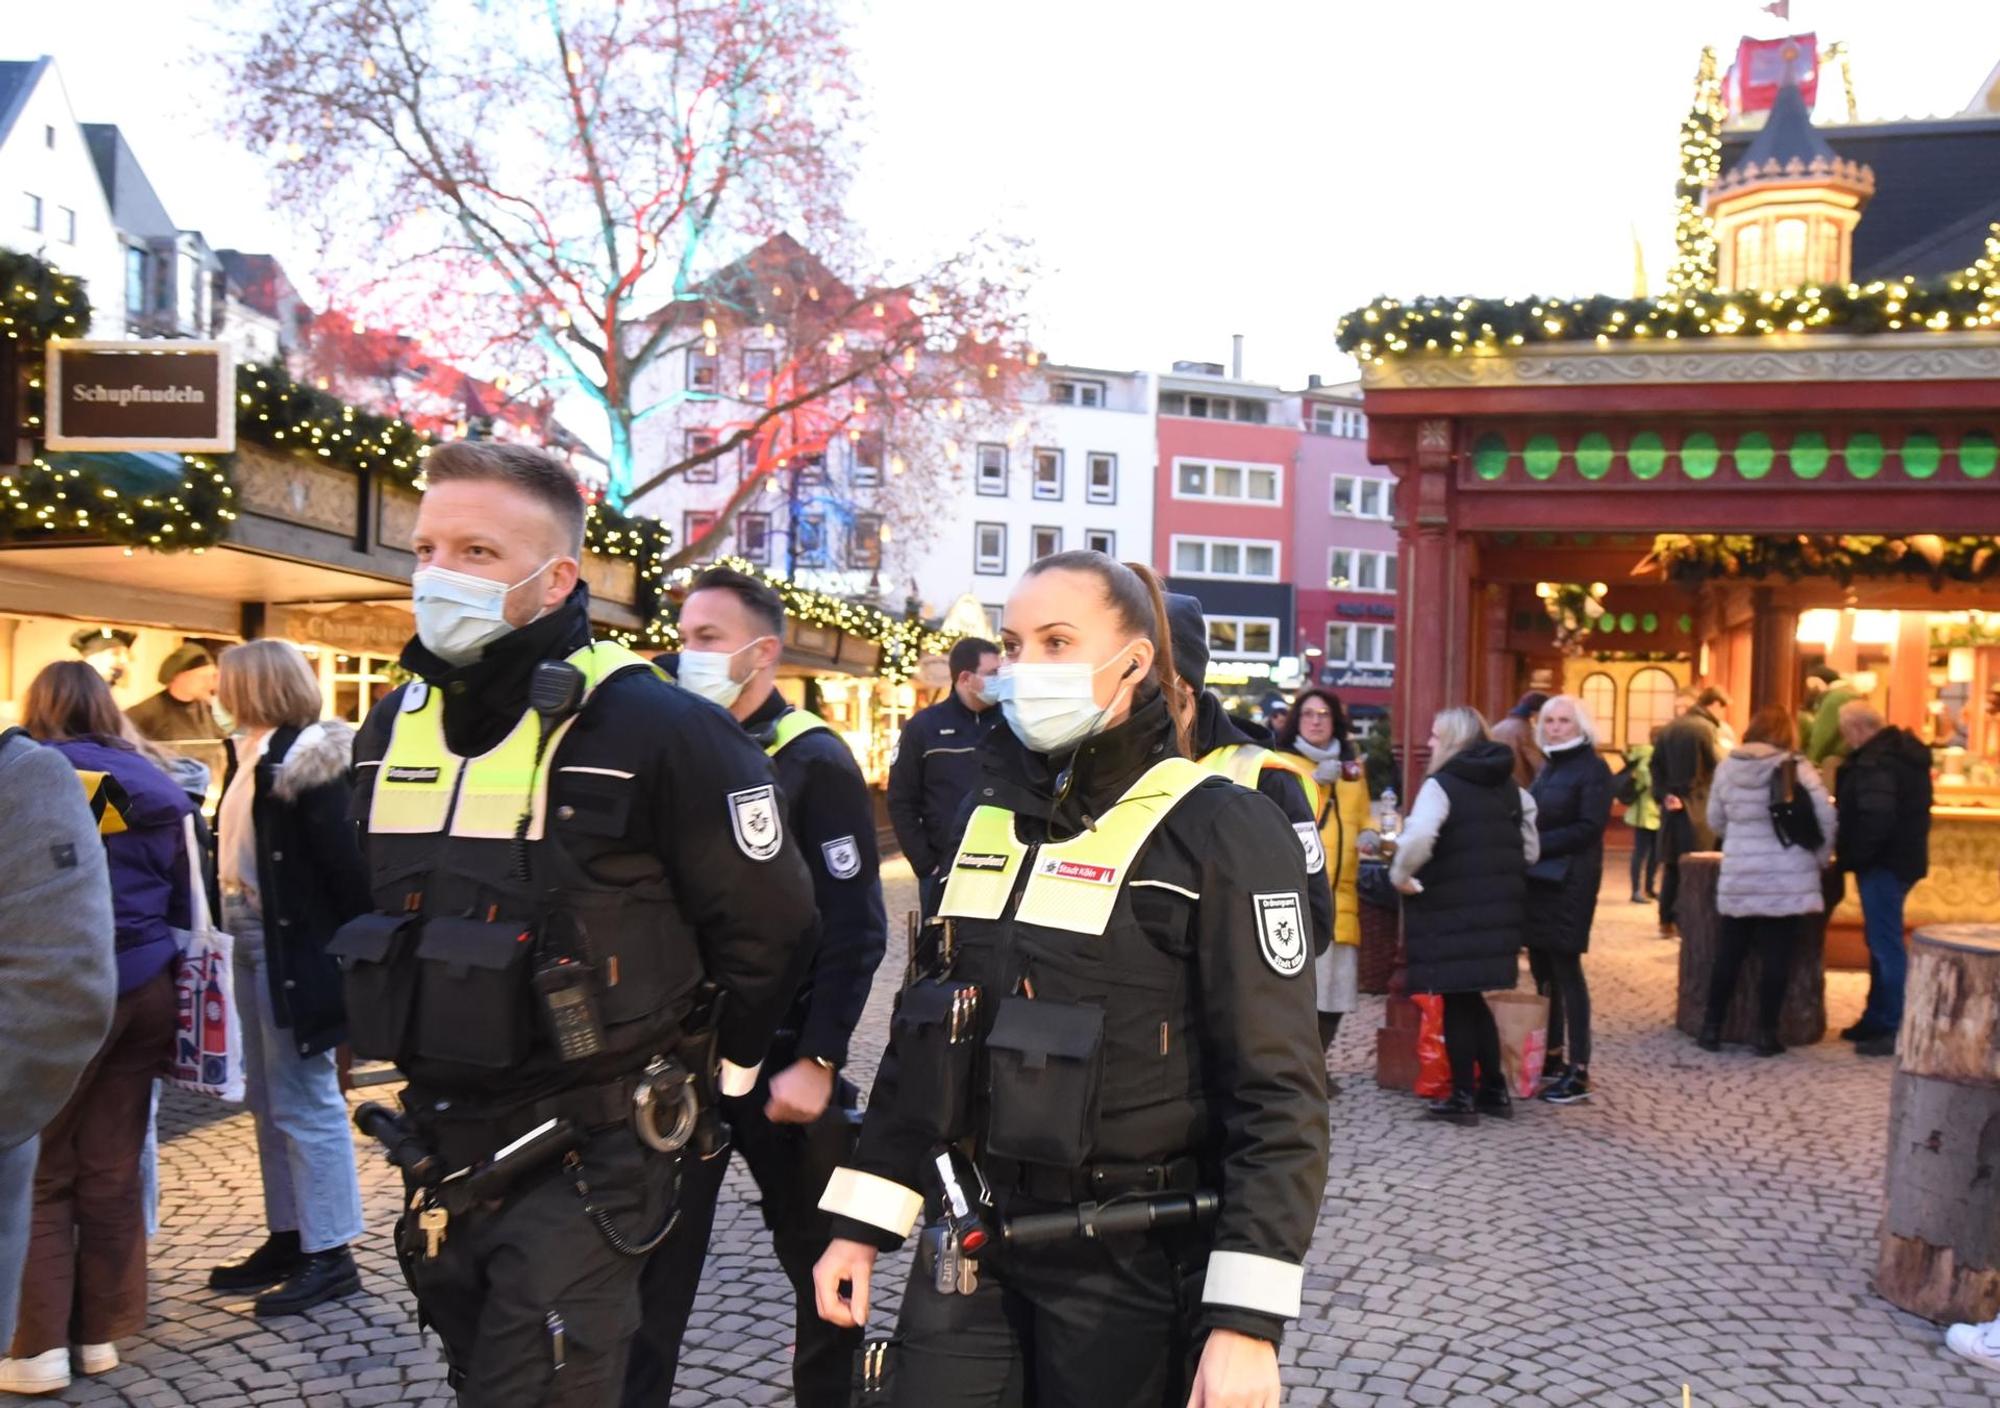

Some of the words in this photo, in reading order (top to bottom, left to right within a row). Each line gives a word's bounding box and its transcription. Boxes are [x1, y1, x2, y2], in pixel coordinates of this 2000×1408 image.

[72, 383, 205, 407] Schupfnudeln
[1059, 864, 1079, 876] Stadt
[1079, 867, 1097, 878] Köln
